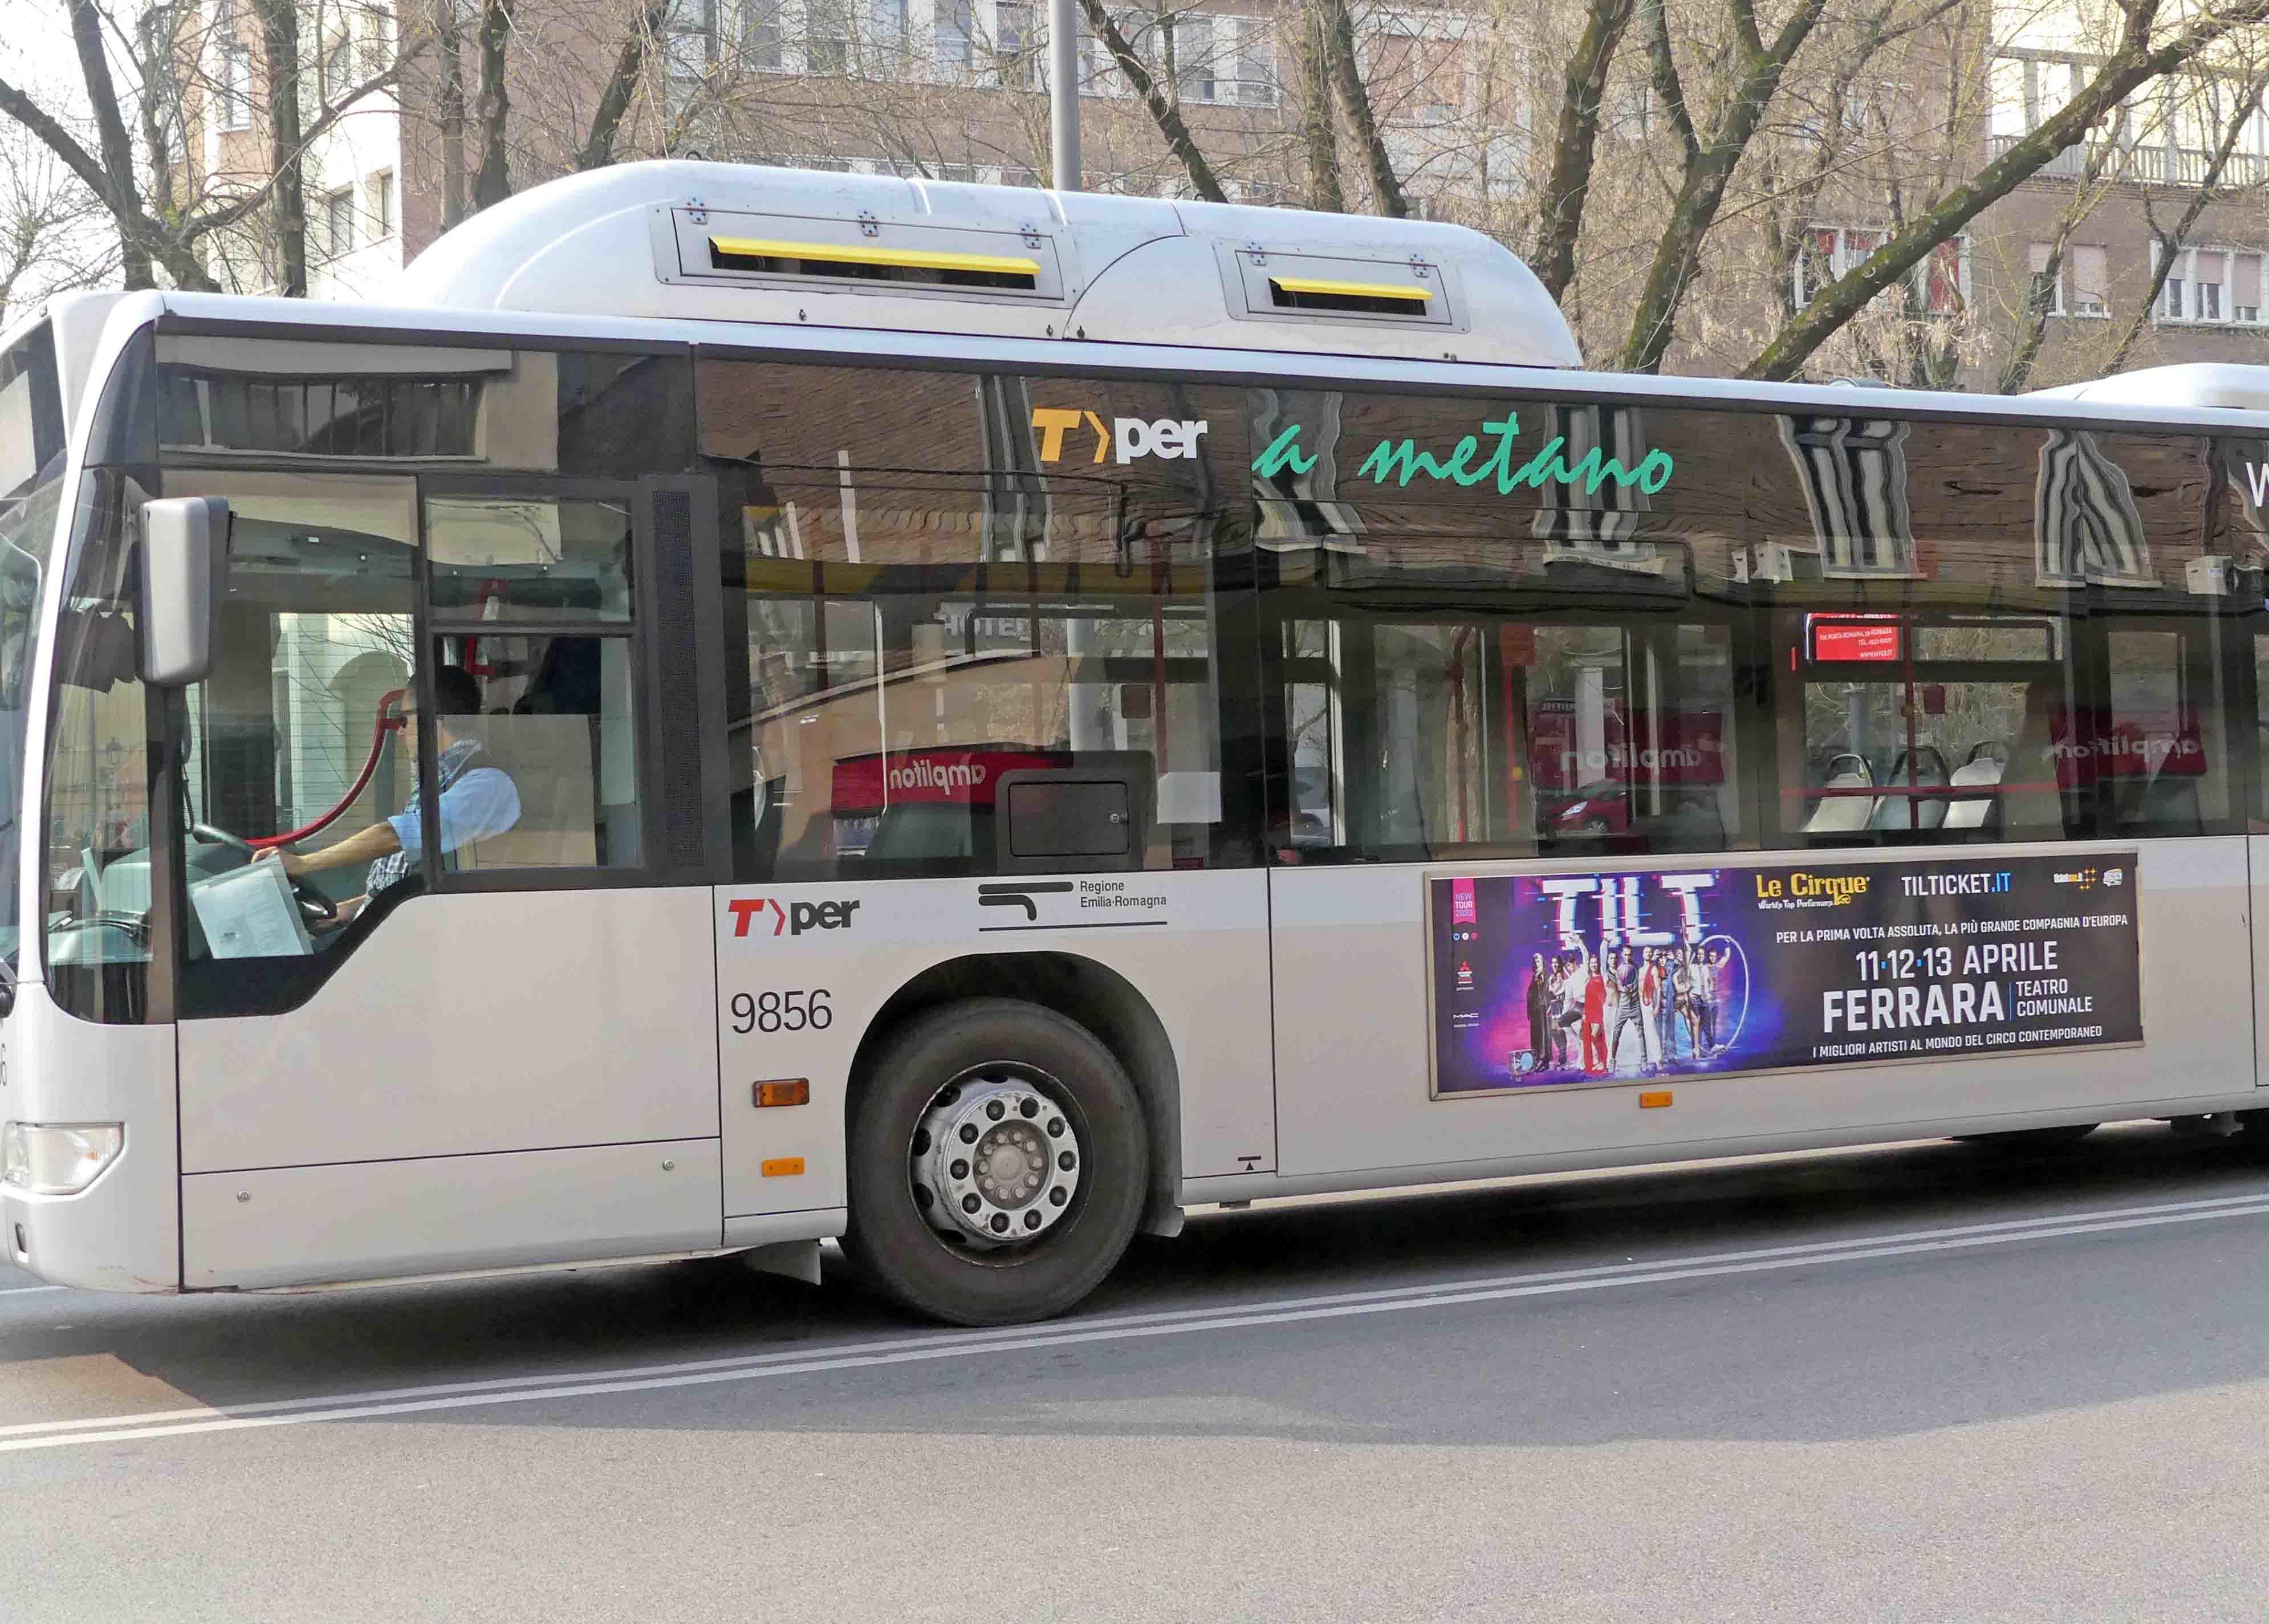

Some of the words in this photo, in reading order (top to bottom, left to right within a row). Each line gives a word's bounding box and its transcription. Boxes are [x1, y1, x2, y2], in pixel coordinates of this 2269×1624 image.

[1251, 424, 1318, 478] a
[1358, 411, 1673, 495] metano
[1080, 880, 1125, 894] Regione
[1756, 874, 1782, 898] Le
[1790, 873, 1867, 905] Cirque
[1901, 873, 2011, 896] TILTICKET.IT
[1538, 874, 1715, 950] TILT
[1783, 899, 1795, 909] Top
[1796, 899, 1833, 908] Performers
[1776, 930, 1796, 943] PER
[1800, 929, 1814, 942] LA
[1816, 928, 1851, 941] PRIMA
[1852, 926, 1885, 939] VOLTA
[1888, 923, 1942, 937] ASSOLUTA,
[1944, 923, 1958, 935] LA
[1961, 919, 1978, 934] PIÙ
[1981, 919, 2020, 932] GRANDE
[2023, 917, 2080, 931] COMPAGNIA
[2082, 914, 2128, 927] D'EUROPA
[1962, 941, 2058, 975] APRILE
[2016, 978, 2068, 997] TEATRO
[731, 989, 832, 1033] 9856
[1823, 981, 2005, 1033] FERRARA
[2017, 996, 2093, 1017] COMUNALE
[1813, 1047, 1817, 1058] I
[1819, 1043, 1865, 1057] MIGLIORI
[1869, 1039, 1908, 1053] ARTISTI
[1910, 1039, 1923, 1051] AL
[1925, 1035, 1962, 1049] MONDO
[1965, 1034, 1983, 1047] DEL
[1986, 1031, 2016, 1045] CIRCO
[2019, 1025, 2103, 1043] CONTEMPORANEO
